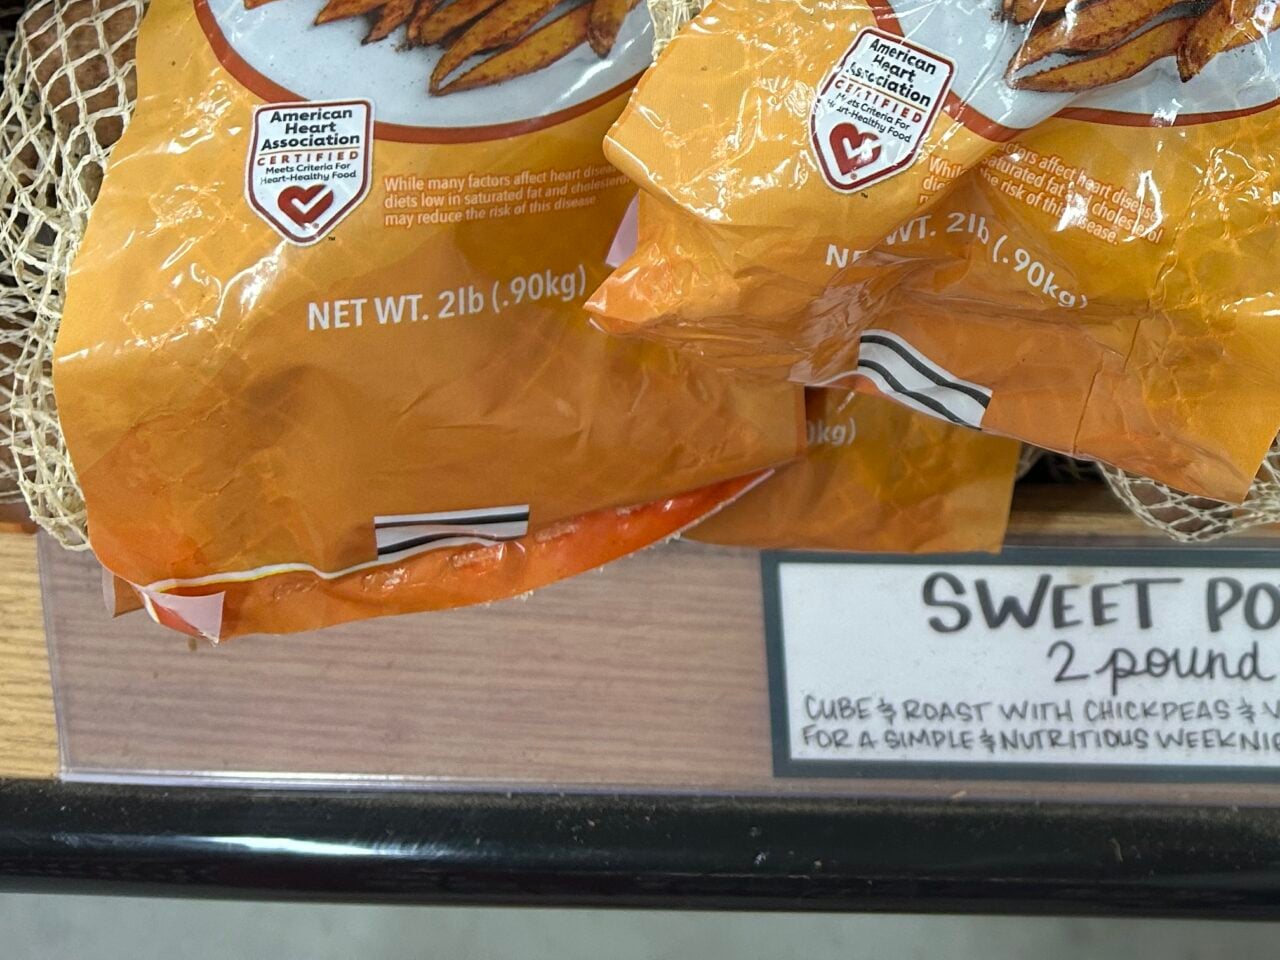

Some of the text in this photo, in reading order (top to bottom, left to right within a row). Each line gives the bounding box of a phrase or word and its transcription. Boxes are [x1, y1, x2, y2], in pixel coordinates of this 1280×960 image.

[869, 38, 937, 76] American
[269, 108, 353, 124] American
[285, 122, 337, 135] Heart
[861, 101, 894, 124] Criteria
[895, 118, 911, 131] For
[260, 133, 360, 151] Association
[887, 126, 913, 143] Food
[257, 150, 359, 166] CERTIFIED
[265, 162, 351, 175] Meets Criteria For
[1001, 142, 1038, 165] ctors
[1039, 155, 1077, 181] affect
[1076, 169, 1112, 199] heart
[260, 170, 357, 185] Heart-Healthy Food
[384, 176, 424, 192] While
[428, 178, 466, 192] many
[468, 173, 511, 188] factors
[513, 170, 546, 185] affect
[550, 168, 580, 183] heart
[1045, 176, 1065, 198] fat
[384, 194, 418, 209] diets
[421, 192, 445, 207] low
[448, 193, 461, 206] in
[464, 188, 524, 205] saturated
[526, 186, 543, 199] fat
[545, 183, 568, 198] and
[1000, 179, 1027, 200] risk
[1026, 191, 1045, 207] of
[384, 213, 414, 228] may
[417, 208, 462, 225] reduce
[465, 206, 486, 220] the
[489, 203, 512, 218] risk
[513, 200, 526, 215] of
[529, 199, 552, 214] this
[946, 211, 990, 245] 2lb
[991, 234, 1089, 310] (.90kg)
[308, 264, 587, 331] NET WT. 2lb (.90kg)
[921, 571, 1184, 633] SWEET
[1046, 640, 1089, 683] 2
[1095, 642, 1275, 697] pound
[804, 694, 872, 722] CUBE
[901, 698, 992, 723] ROAST
[997, 699, 1074, 724] WITH
[1083, 698, 1231, 723] CHICKPEAS
[801, 724, 852, 749] FOR
[859, 730, 878, 750] A
[884, 729, 973, 750] SIMPLE
[1001, 728, 1149, 751] NUTRITIOUS
